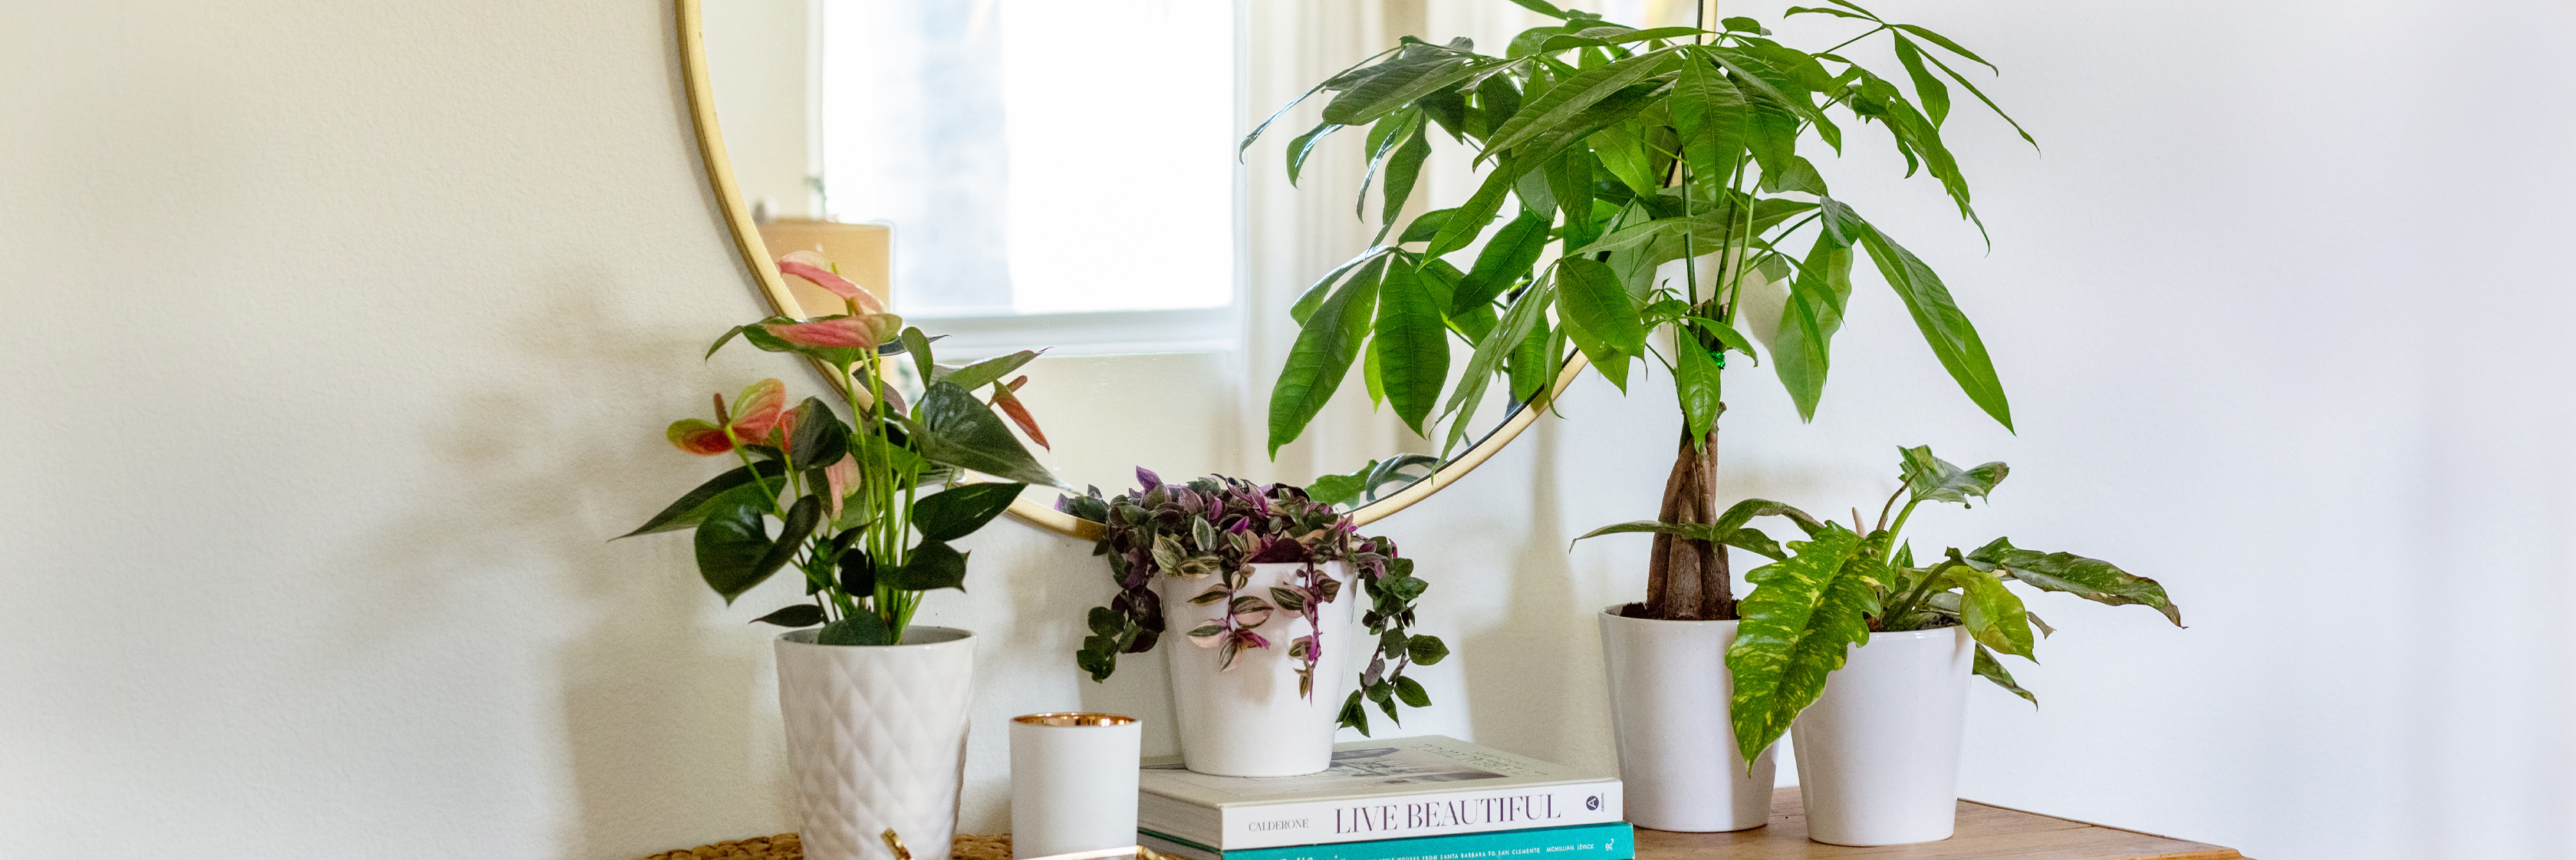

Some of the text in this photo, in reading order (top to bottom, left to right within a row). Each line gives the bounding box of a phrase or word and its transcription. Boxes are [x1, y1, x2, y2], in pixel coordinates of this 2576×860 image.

[1249, 819, 1308, 832] CALDERONE
[1334, 793, 1561, 834] LIVE BEAUTIFUL
